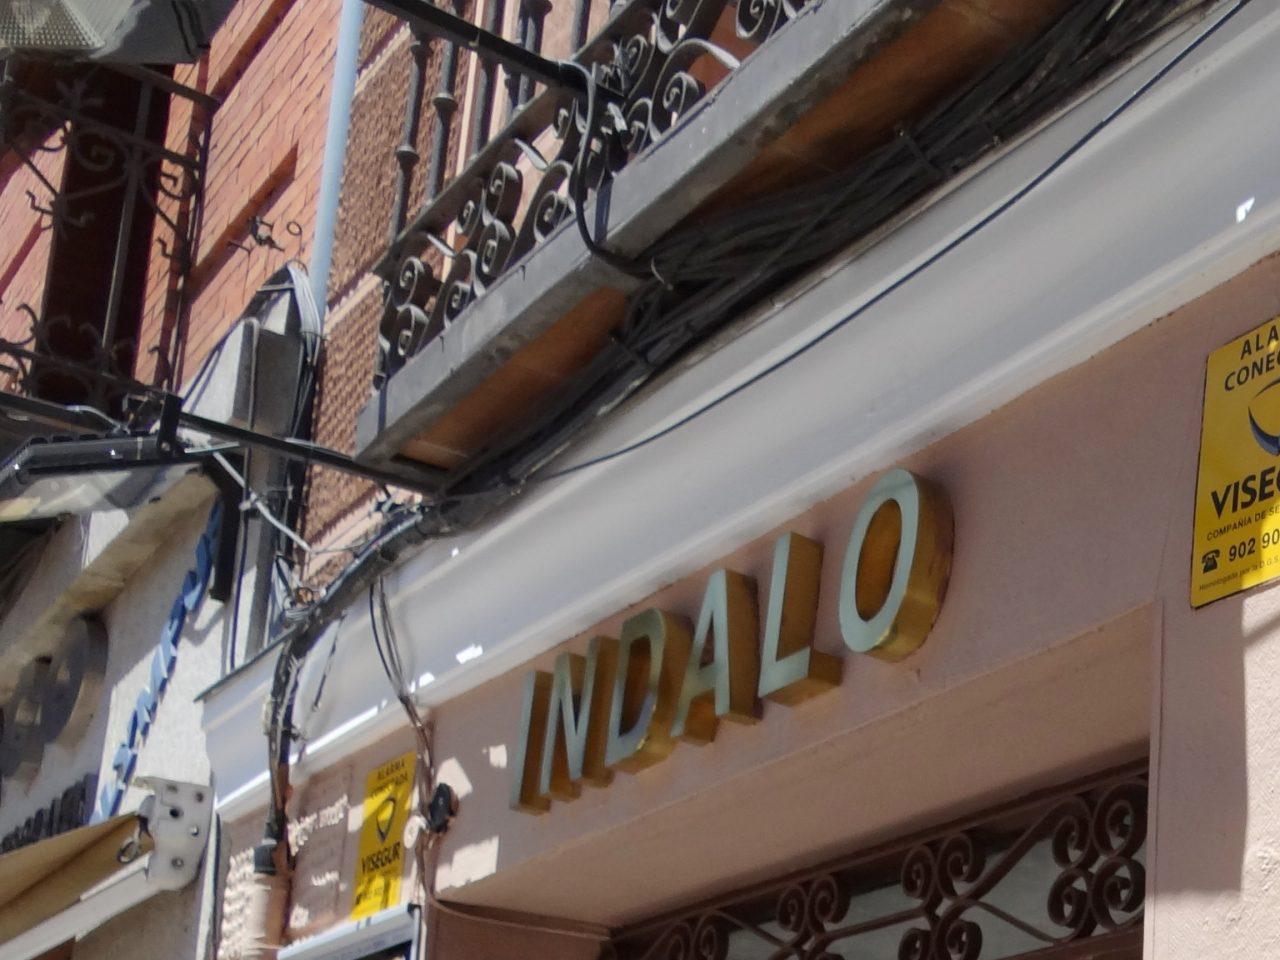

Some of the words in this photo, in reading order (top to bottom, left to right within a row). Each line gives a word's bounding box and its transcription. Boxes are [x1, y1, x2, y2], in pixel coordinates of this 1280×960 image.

[1254, 509, 1266, 522] DE
[1228, 538, 1256, 562] 902
[513, 468, 945, 813] INDALO
[361, 841, 400, 873] VISEGUR
